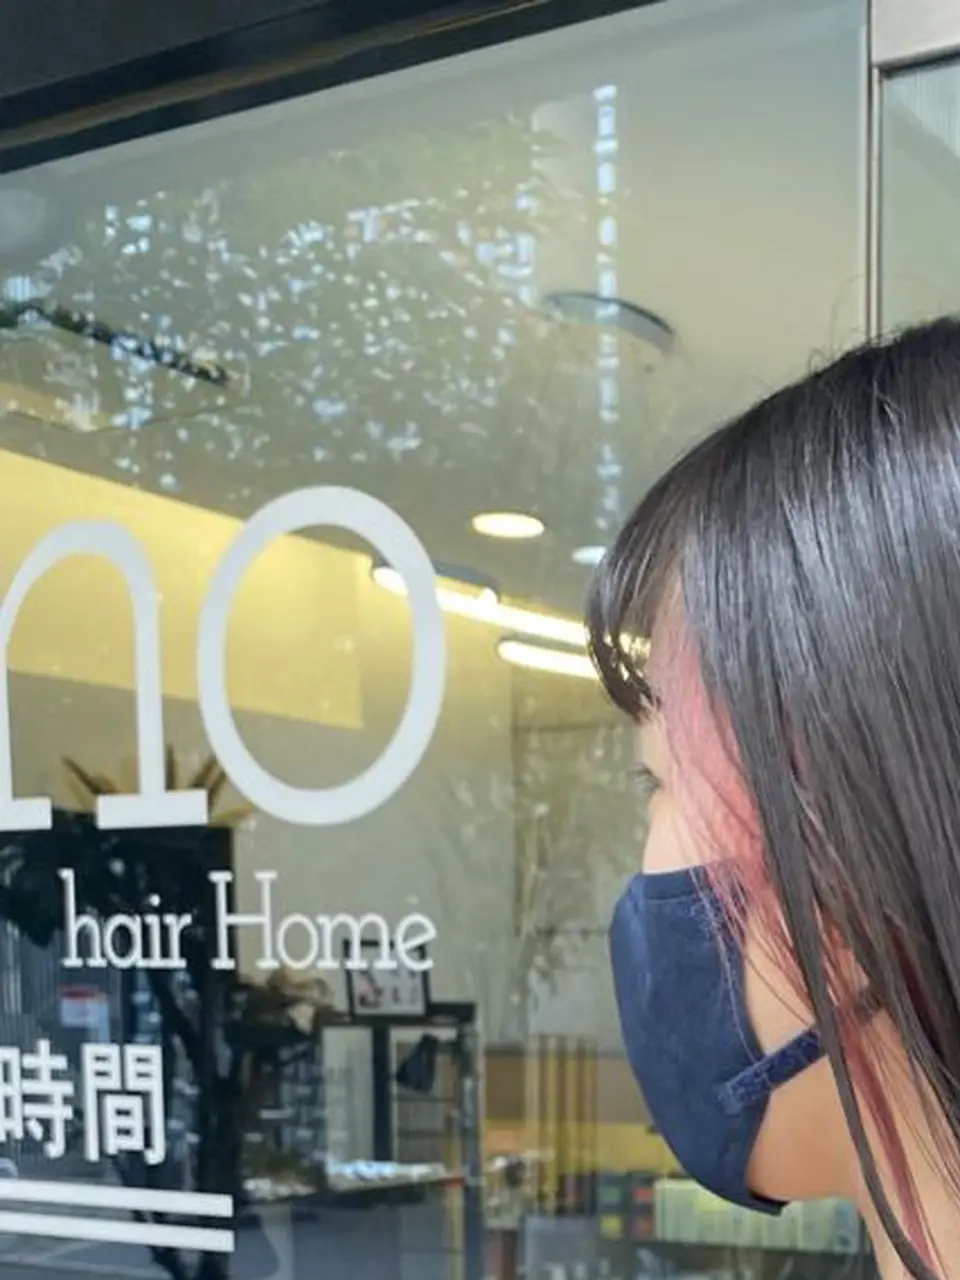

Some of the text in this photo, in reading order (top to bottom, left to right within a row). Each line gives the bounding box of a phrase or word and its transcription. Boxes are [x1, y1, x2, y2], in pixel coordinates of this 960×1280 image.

[58, 869, 436, 970] hair Home
[0, 1038, 166, 1166] 時間
